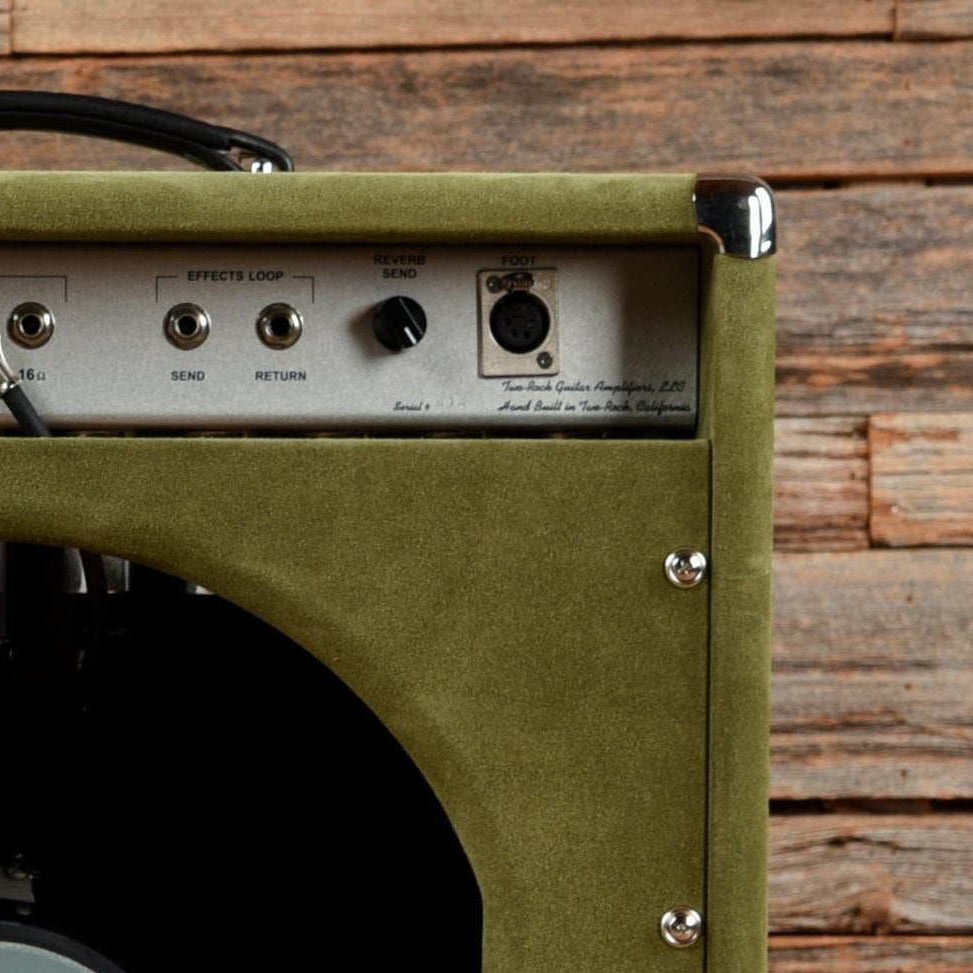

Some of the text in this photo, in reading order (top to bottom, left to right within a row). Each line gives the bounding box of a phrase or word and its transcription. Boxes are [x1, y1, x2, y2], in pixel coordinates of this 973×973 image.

[374, 254, 426, 266] REVERB
[502, 255, 537, 266] FOOT
[187, 271, 284, 282] EFFECTS LOOP
[382, 268, 417, 280] SEND
[171, 371, 205, 381] SEND
[255, 371, 307, 381] RETURN
[502, 380, 552, 393] Two-Rock
[555, 380, 590, 394] Guitar
[658, 380, 685, 393] LLC
[393, 402, 422, 411] Serial
[498, 401, 532, 412] Hand
[534, 400, 562, 411] Built
[564, 402, 576, 411] in
[636, 401, 692, 416] California
